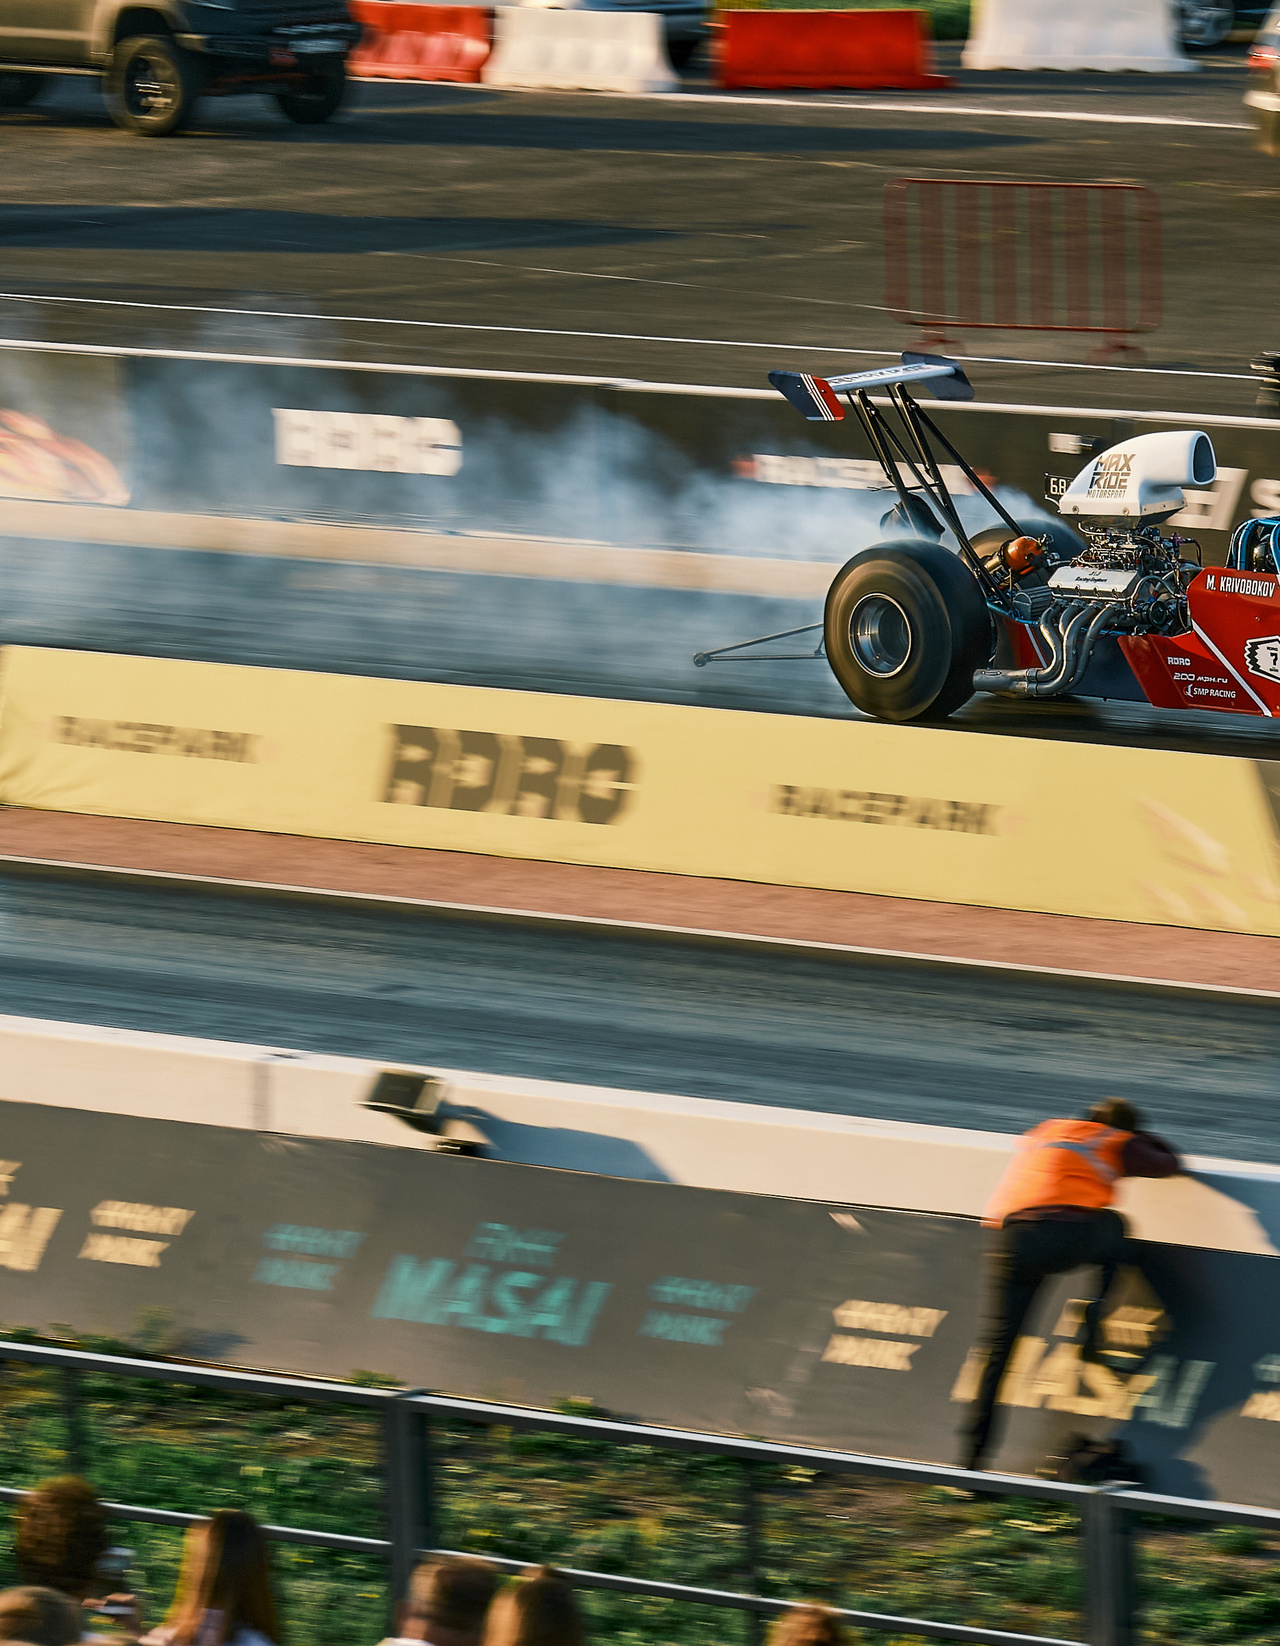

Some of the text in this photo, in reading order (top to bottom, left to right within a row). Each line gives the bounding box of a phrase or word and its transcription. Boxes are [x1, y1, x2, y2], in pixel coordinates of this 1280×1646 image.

[1094, 453, 1136, 471] MAX
[1086, 489, 1127, 499] MOTORSPORT
[1206, 574, 1276, 598] M. KRIVOBOKOV
[1269, 652, 1279, 666] 7
[1173, 672, 1196, 681] 200
[1193, 687, 1237, 699] SMP RACING
[370, 1252, 614, 1347] MASAI
